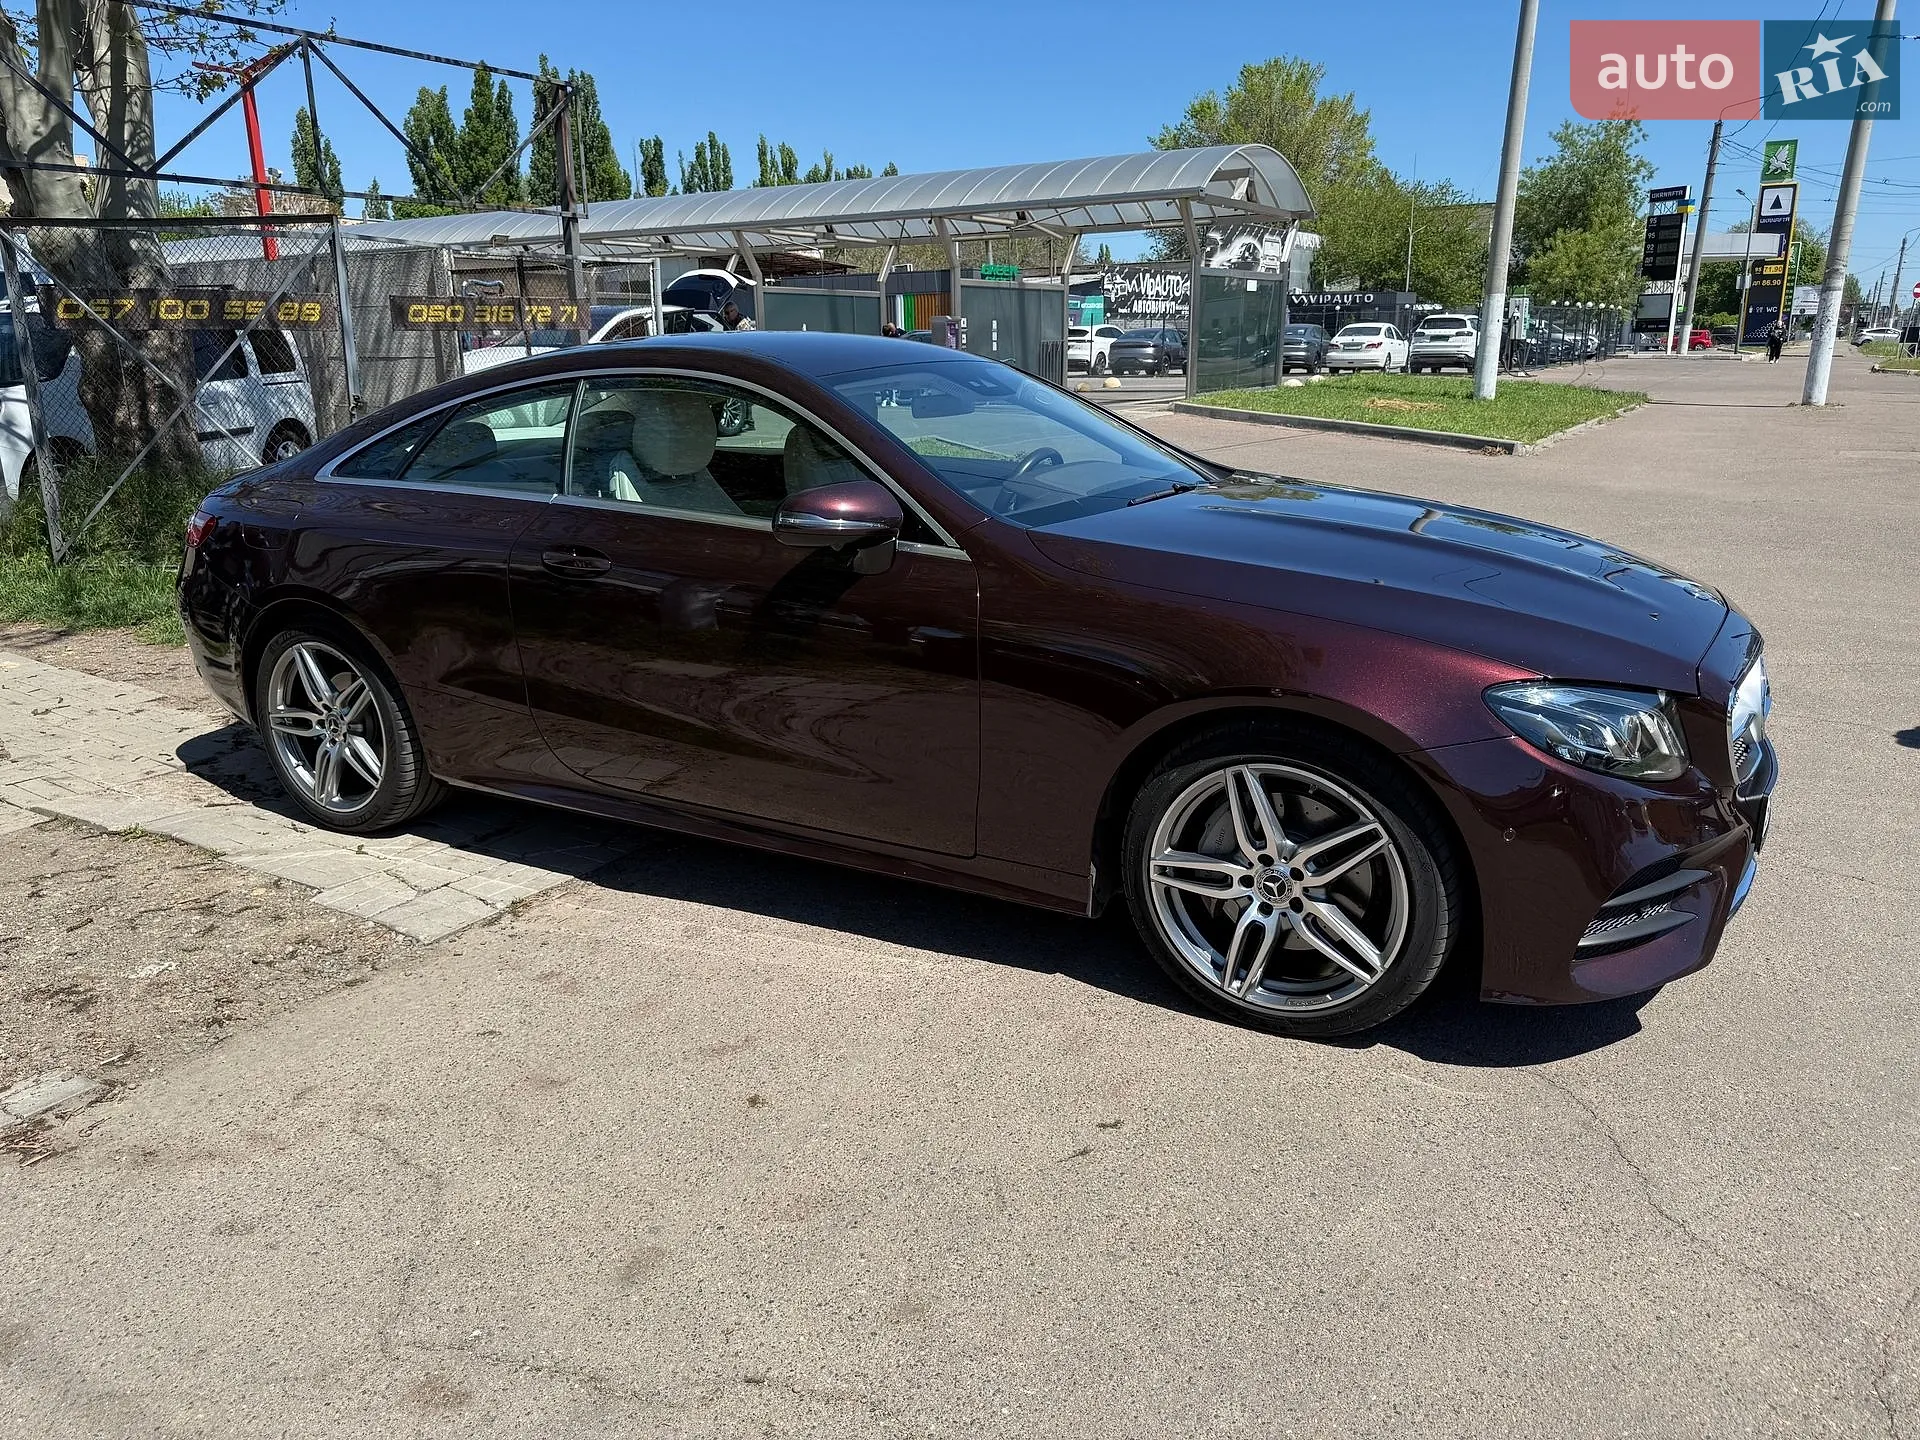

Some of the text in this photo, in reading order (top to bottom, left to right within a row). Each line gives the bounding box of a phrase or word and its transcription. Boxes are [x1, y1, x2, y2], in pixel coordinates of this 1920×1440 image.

[1309, 293, 1374, 304] VIPAUTO
[150, 298, 210, 320] 100
[277, 301, 321, 323] 88
[408, 304, 578, 323] 050 316 72 71
